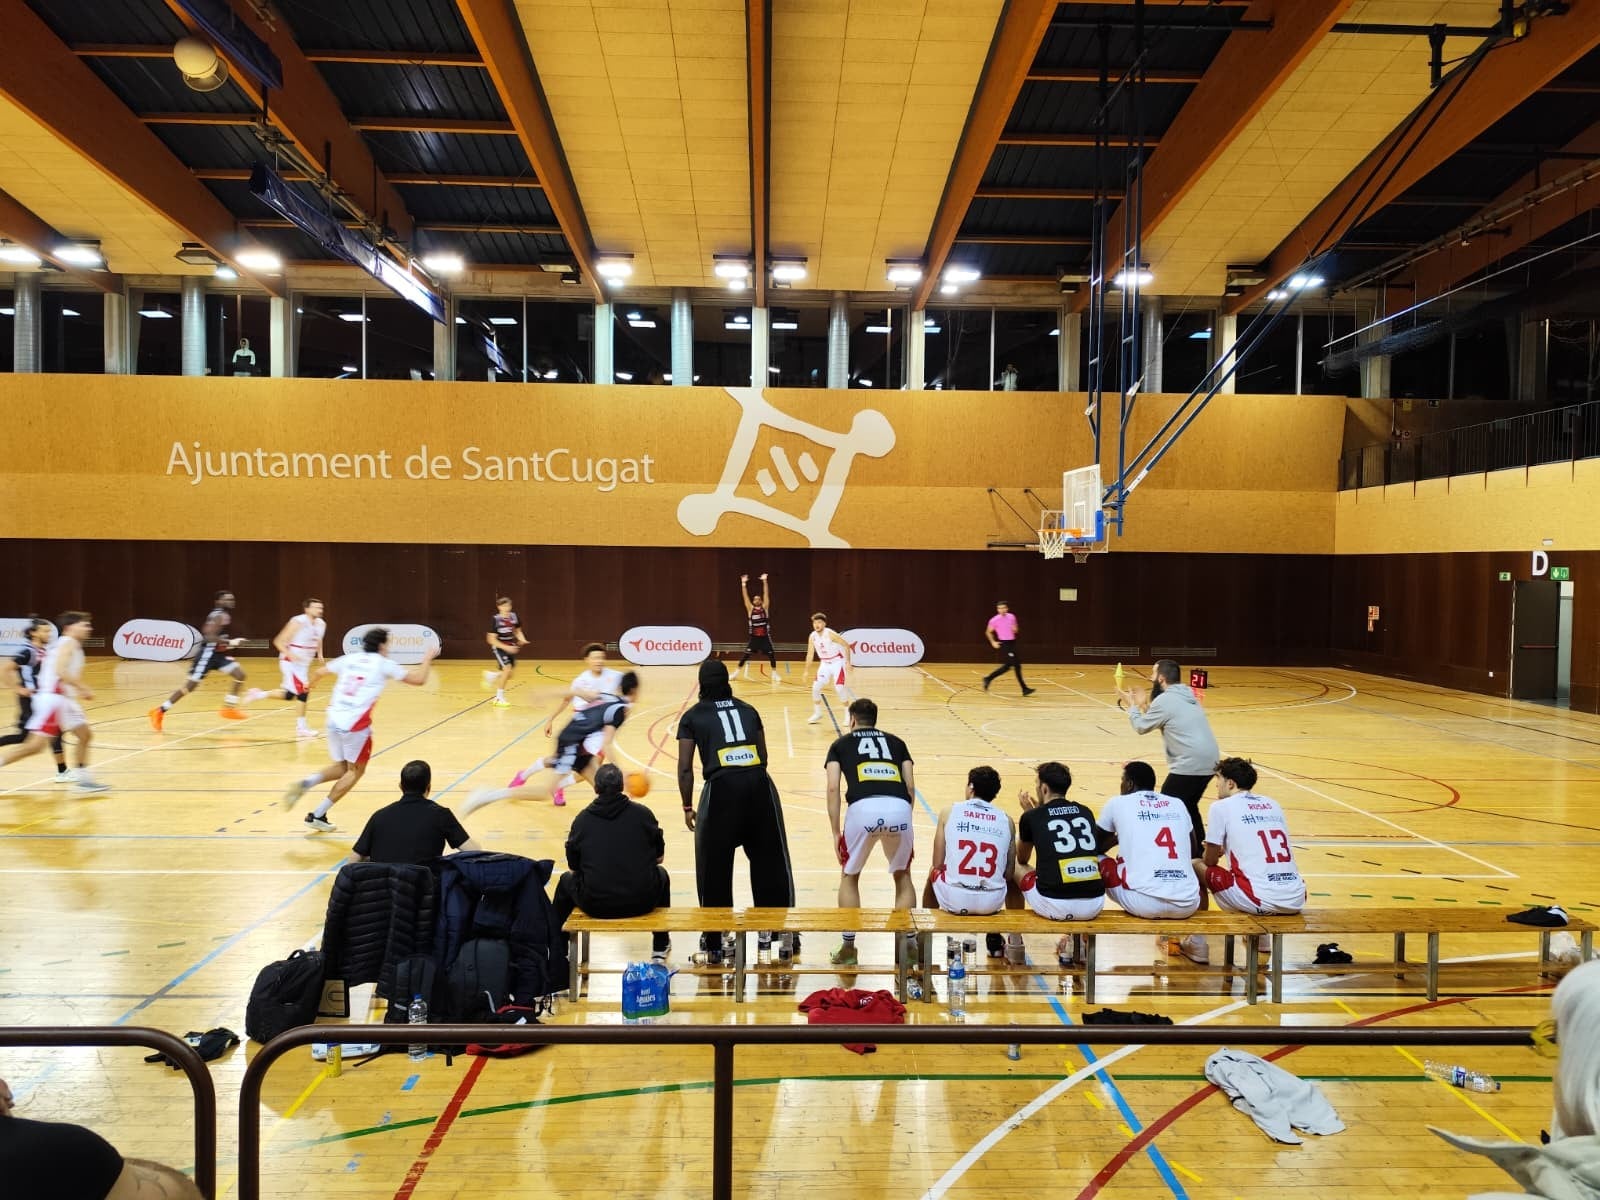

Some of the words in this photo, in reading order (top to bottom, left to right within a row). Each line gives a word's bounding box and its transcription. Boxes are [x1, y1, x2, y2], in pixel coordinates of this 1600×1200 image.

[166, 441, 392, 485] Ajuntament
[404, 445, 453, 480] de
[462, 446, 655, 492] SantCugat
[1532, 551, 1549, 577] D
[133, 633, 185, 649] Occident
[645, 640, 704, 651] Occident
[860, 641, 918, 653] Occident
[1191, 674, 1204, 688] 21
[717, 708, 747, 743] 11
[857, 737, 893, 760] 41
[725, 752, 754, 762] Bada
[863, 767, 896, 775] Bada
[963, 810, 997, 821] SARTOR
[1048, 805, 1080, 816] RODRIGO
[1047, 816, 1096, 853] 33
[1154, 826, 1178, 859] 4
[1257, 829, 1292, 864] 13
[958, 839, 998, 878] 23
[1067, 865, 1098, 874] Bada
